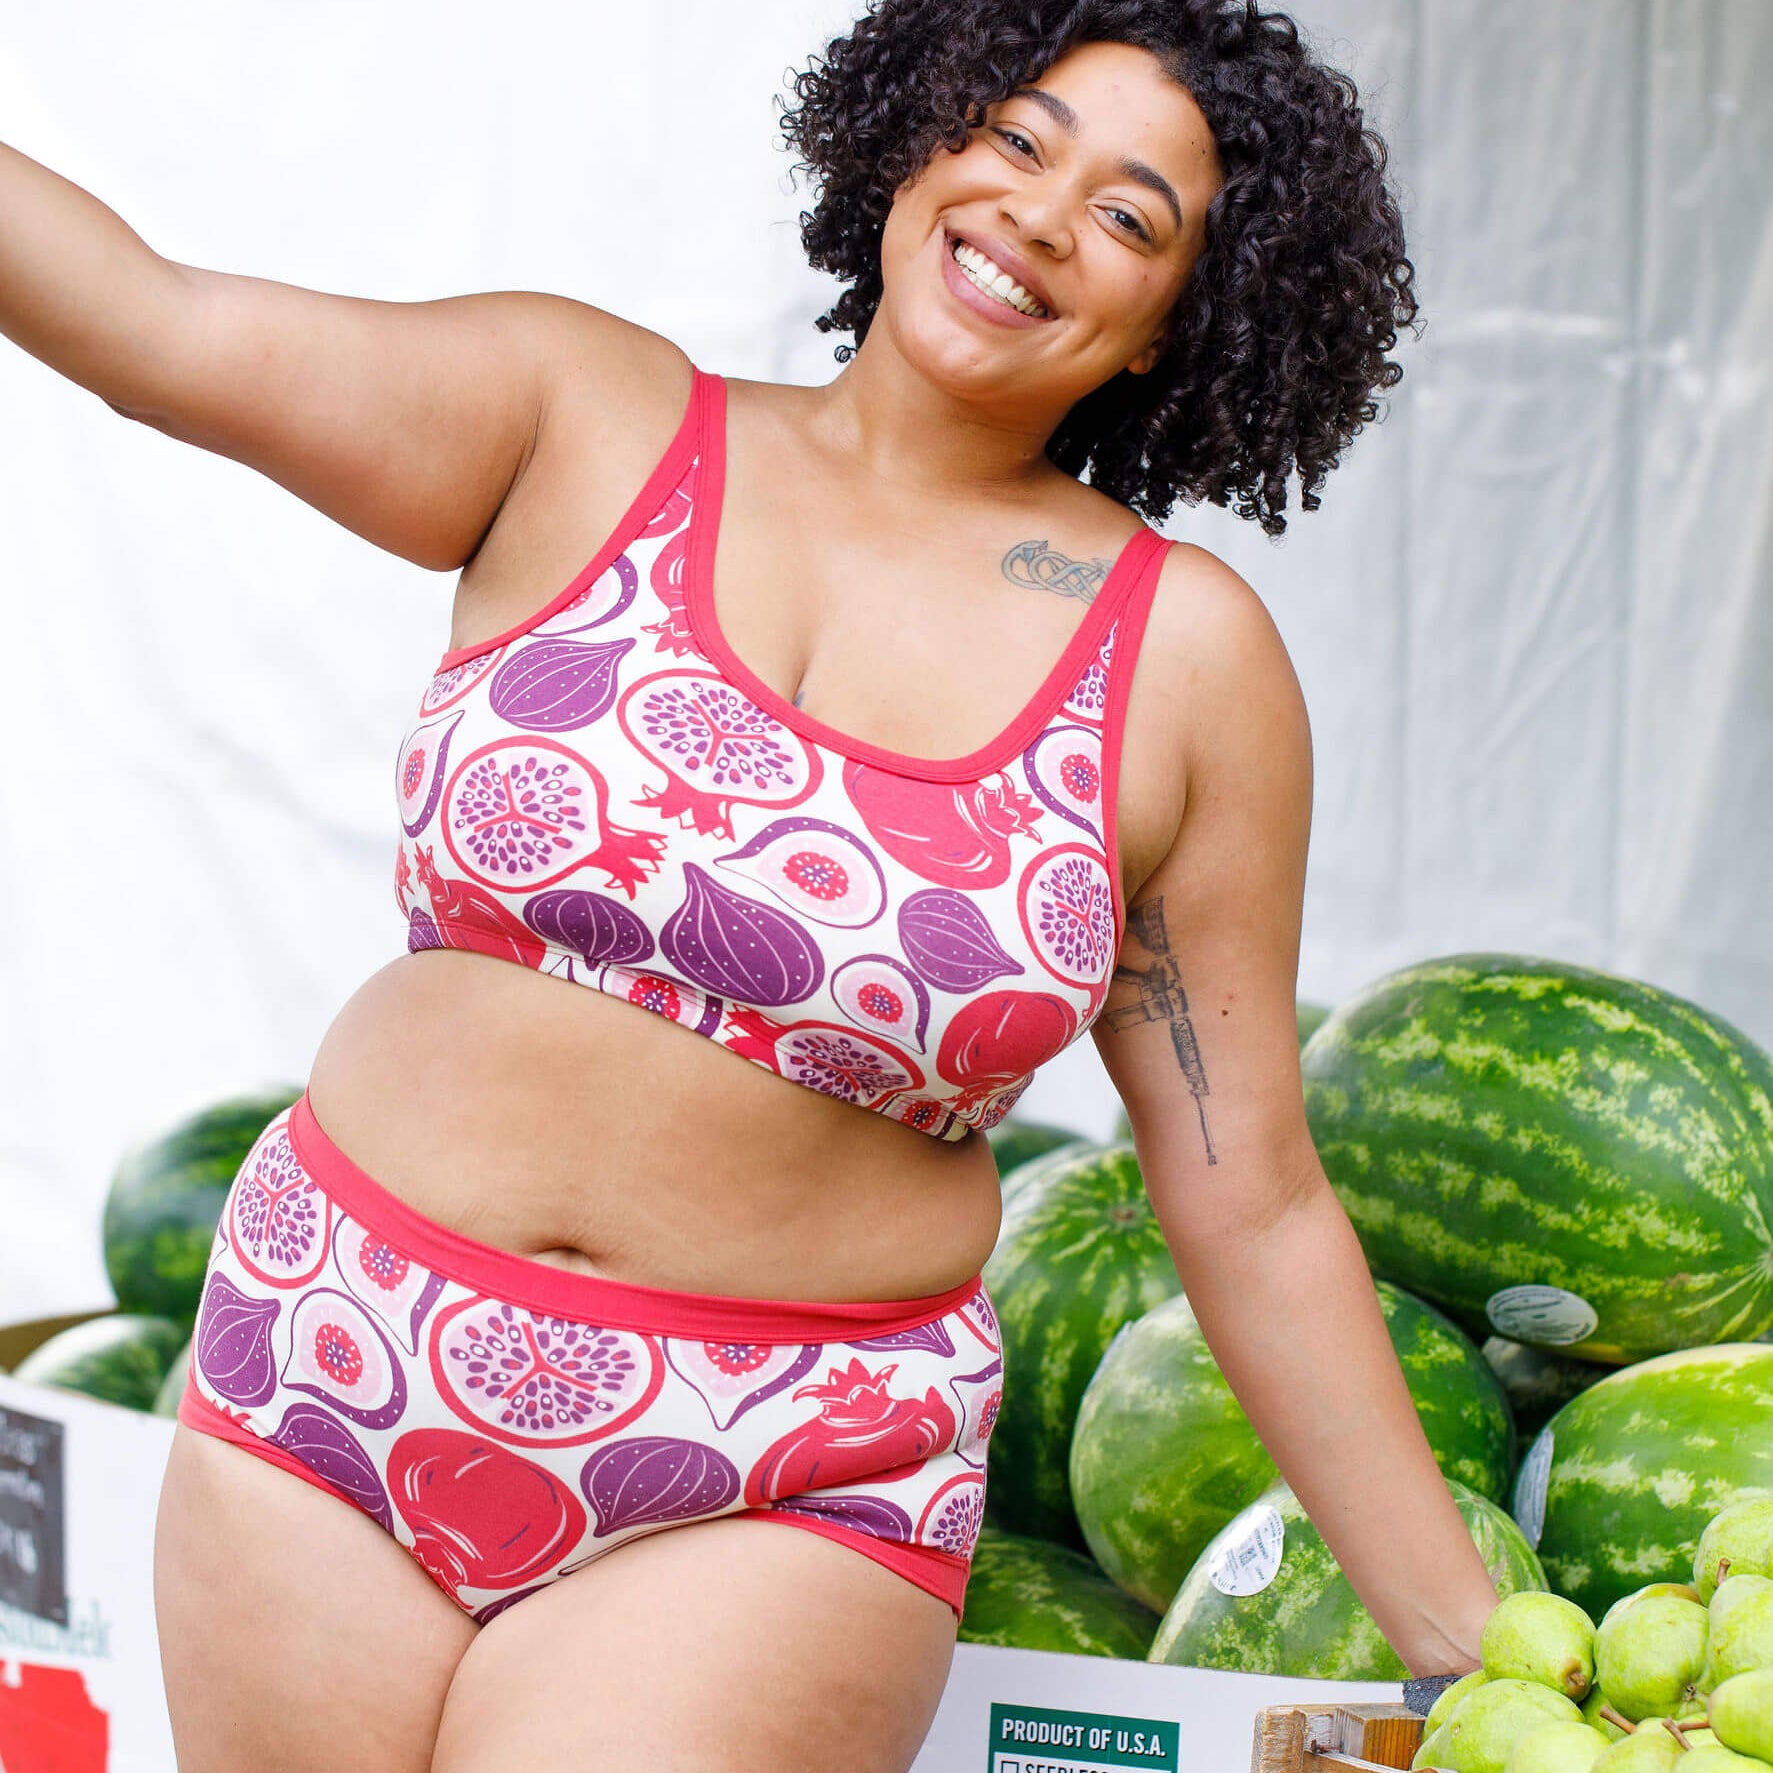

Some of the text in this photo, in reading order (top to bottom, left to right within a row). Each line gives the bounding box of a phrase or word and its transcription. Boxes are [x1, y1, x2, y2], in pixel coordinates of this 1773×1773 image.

[1002, 1718, 1167, 1757] PRODUCT OF U.S.A.
